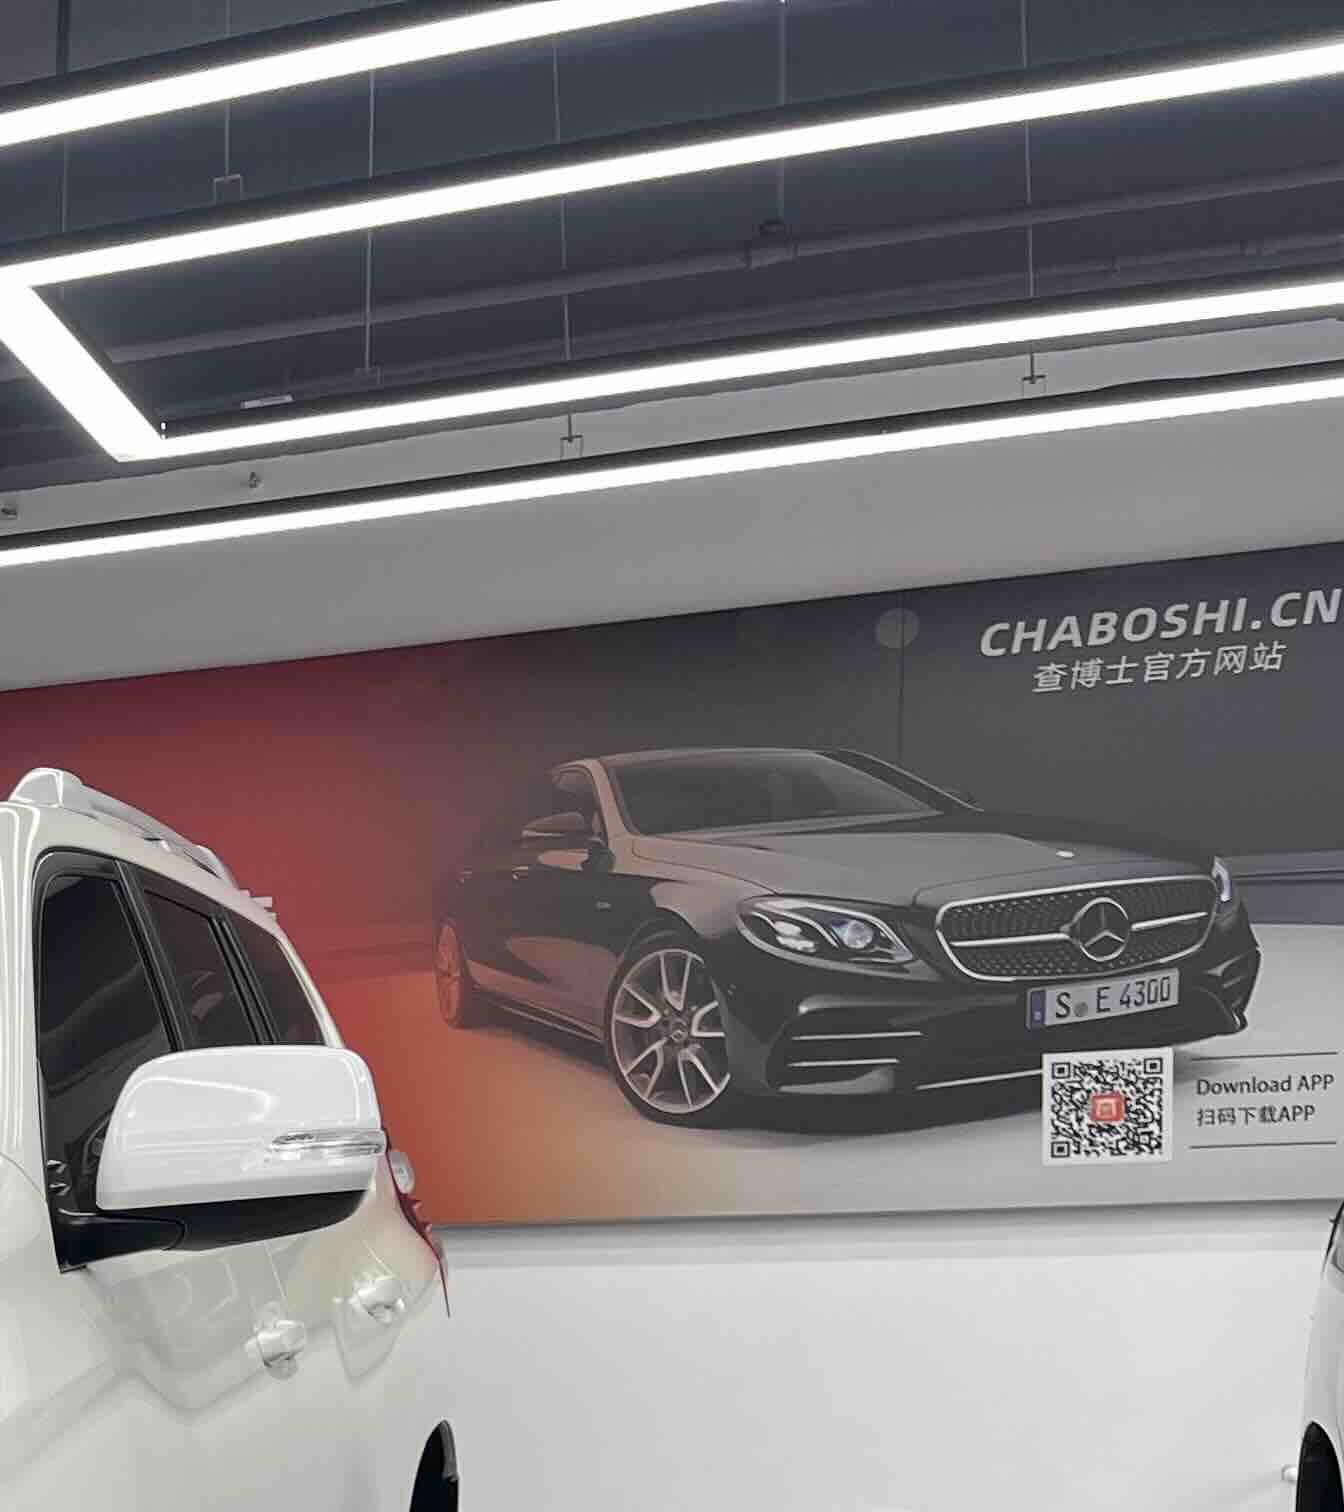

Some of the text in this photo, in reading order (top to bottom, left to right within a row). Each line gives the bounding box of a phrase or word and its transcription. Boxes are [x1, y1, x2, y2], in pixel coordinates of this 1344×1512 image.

[979, 588, 1343, 657] CHABOSHI.CN
[1032, 640, 1287, 694] 查博士官方网站
[1055, 976, 1171, 1019] S E 4300
[1196, 1073, 1335, 1096] Download APP
[1196, 1104, 1316, 1127] 扫码下载APP
